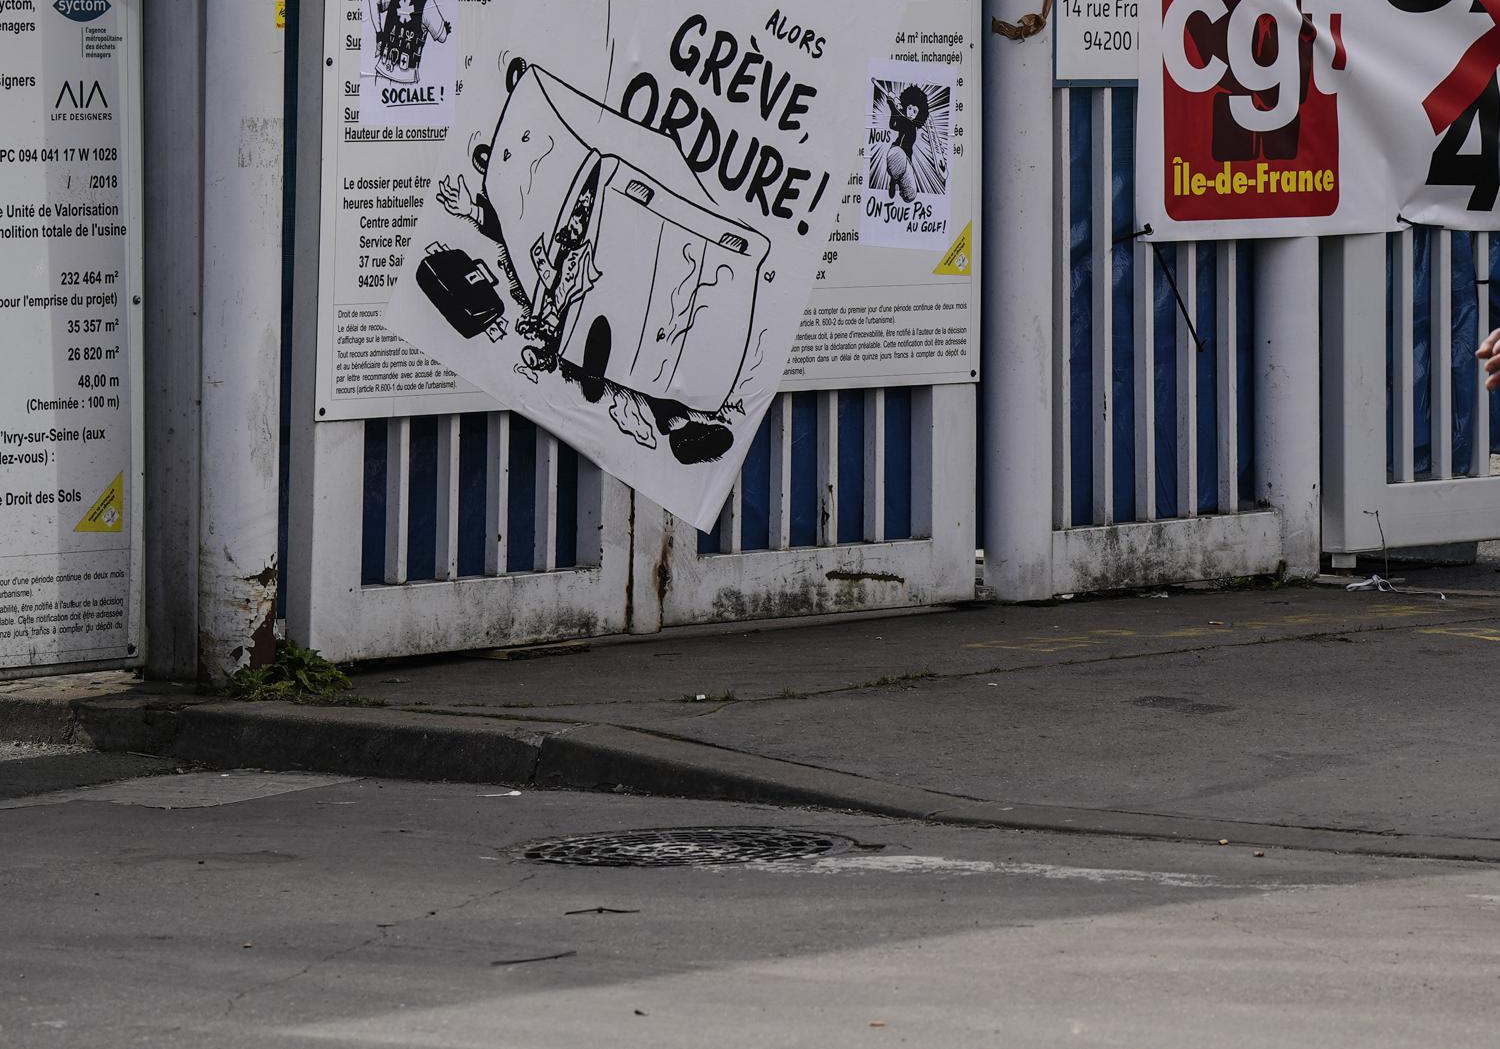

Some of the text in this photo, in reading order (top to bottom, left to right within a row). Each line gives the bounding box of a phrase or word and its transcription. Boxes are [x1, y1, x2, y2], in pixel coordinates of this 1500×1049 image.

[1087, 2, 1110, 18] rue
[85, 35, 123, 43] métropolitaine
[765, 9, 828, 59] ALORS
[907, 32, 963, 46] m² inchangée
[1084, 30, 1132, 51] 94200
[85, 51, 111, 59] ménagers
[922, 52, 963, 64] inchangée)
[669, 14, 818, 145] GRÈVE,
[381, 86, 445, 104] SOCIALE !
[51, 112, 113, 121] LIFE DESIGNERS
[345, 125, 404, 140] Hauteur de la
[869, 128, 891, 144] NOUS
[19, 149, 38, 162] 094
[41, 149, 59, 162] 041
[63, 148, 76, 161] 17
[78, 148, 90, 161] W
[92, 148, 118, 161] 1028
[621, 72, 831, 236] ORDURE!
[343, 174, 432, 193] Le dossier peut être
[1173, 156, 1335, 196] Île-de-France
[6, 203, 119, 218] Unité de Valorisation
[343, 196, 424, 210] heures habituelles
[866, 196, 932, 223] ON JOUE PAS
[42, 224, 73, 238] totale
[75, 223, 89, 237] de
[92, 223, 127, 236] l'usine
[360, 217, 389, 229] Centre
[906, 220, 947, 234] AU GOLF!
[359, 236, 391, 249] Service
[358, 256, 387, 268] 37 rue
[61, 270, 119, 285] 232 464 m²
[358, 275, 384, 288] 94205
[23, 293, 118, 309] l'emprise du projet)
[338, 310, 351, 318] Droit
[352, 310, 359, 318] de
[67, 318, 119, 333] 35 357 m²
[68, 346, 120, 361] 26 820 m²
[78, 374, 119, 390] 48,00 m
[336, 384, 356, 394] recours
[26, 395, 120, 413] (Cheminée 100 m)
[82, 427, 105, 443] (aux
[6, 489, 82, 506] Droit des Sols
[12, 570, 125, 585] d'une période continue deux mois
